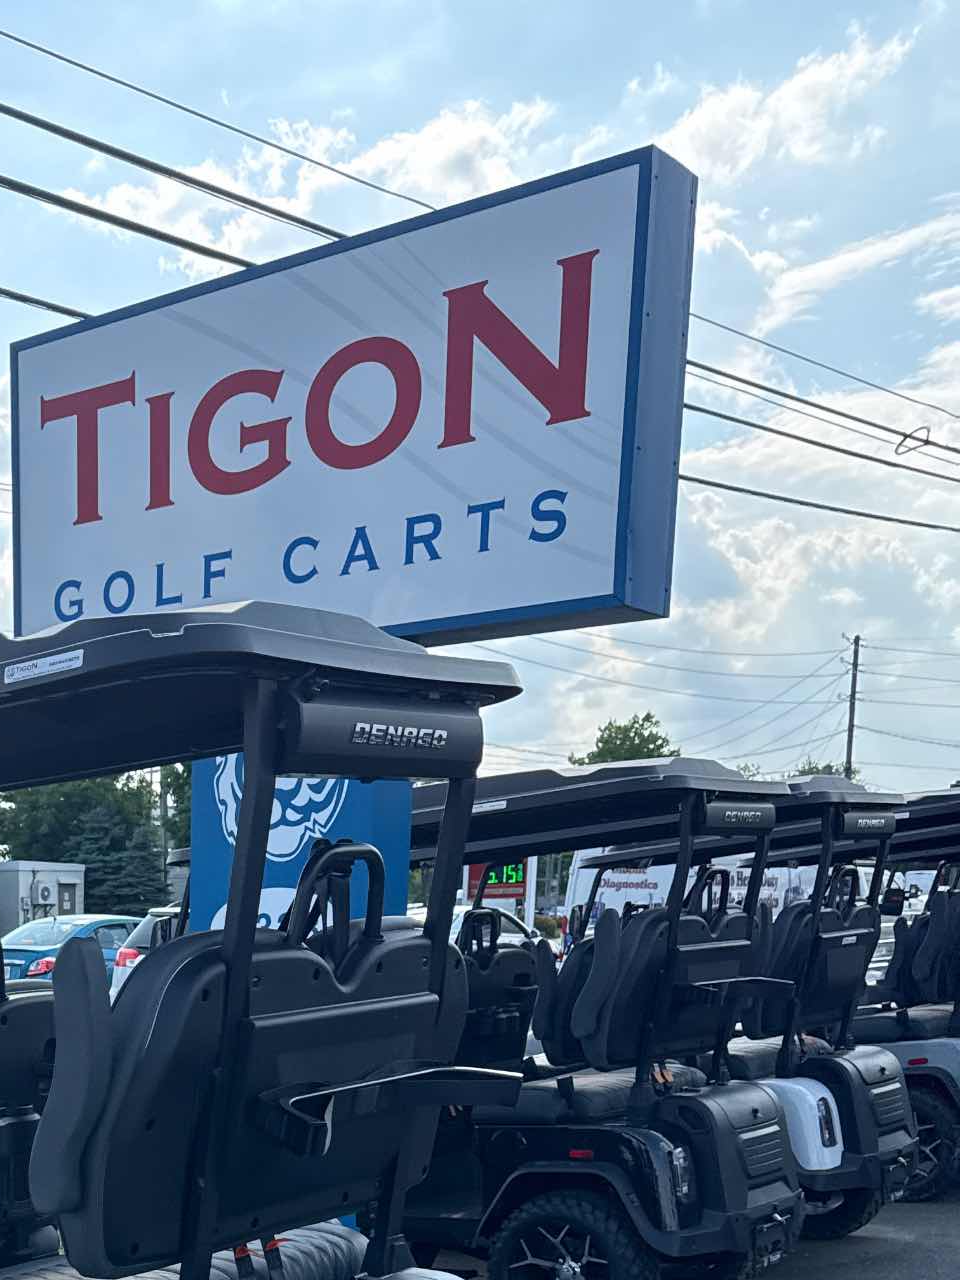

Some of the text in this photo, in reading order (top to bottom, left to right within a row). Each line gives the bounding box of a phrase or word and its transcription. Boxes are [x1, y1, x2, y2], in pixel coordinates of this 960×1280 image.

[41, 249, 600, 526] TIGON
[54, 490, 568, 622] GOLF CARTS
[352, 722, 448, 749] DENAGO
[599, 878, 658, 891] Diagnostics
